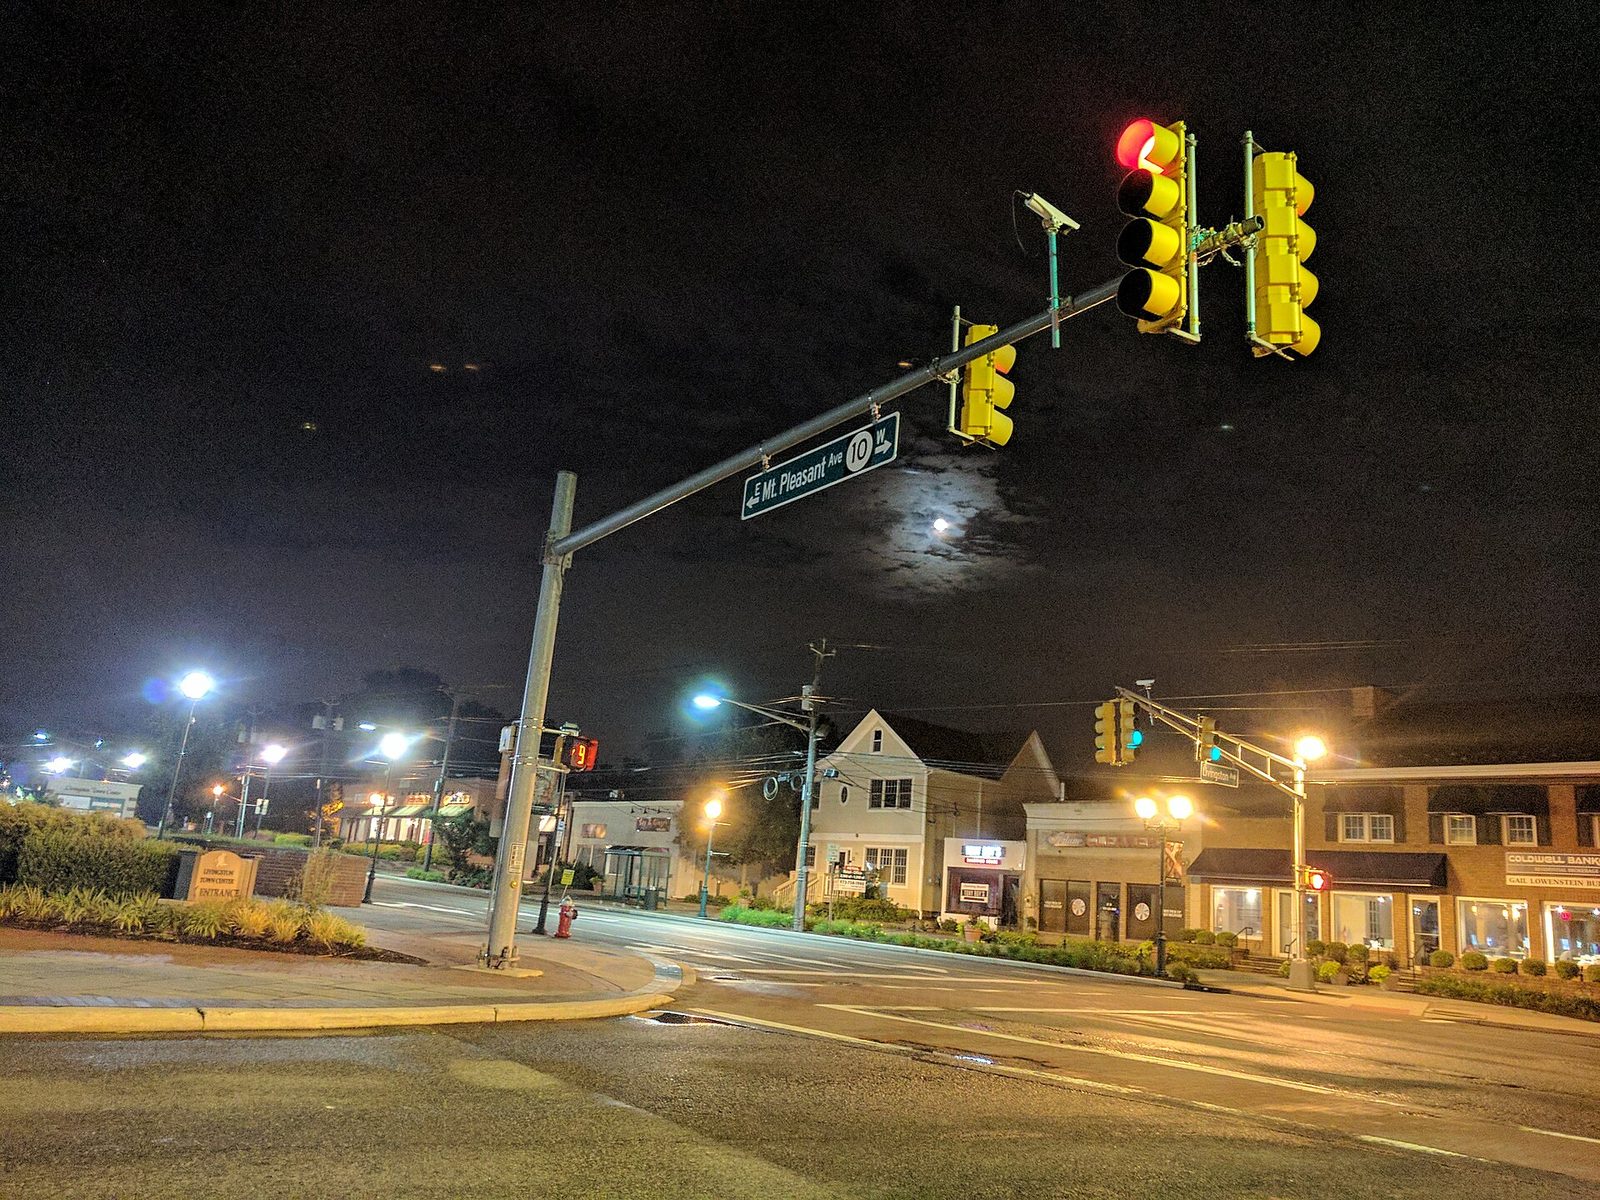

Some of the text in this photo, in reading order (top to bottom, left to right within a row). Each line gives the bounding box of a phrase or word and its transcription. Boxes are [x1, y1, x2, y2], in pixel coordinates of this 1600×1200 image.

[754, 428, 886, 502] E Mt. Pleasant Ave 10 W
[1508, 854, 1566, 864] COLDWELL
[1530, 878, 1583, 887] LOWENSTEIN
[200, 888, 240, 898] ENTRANCE
